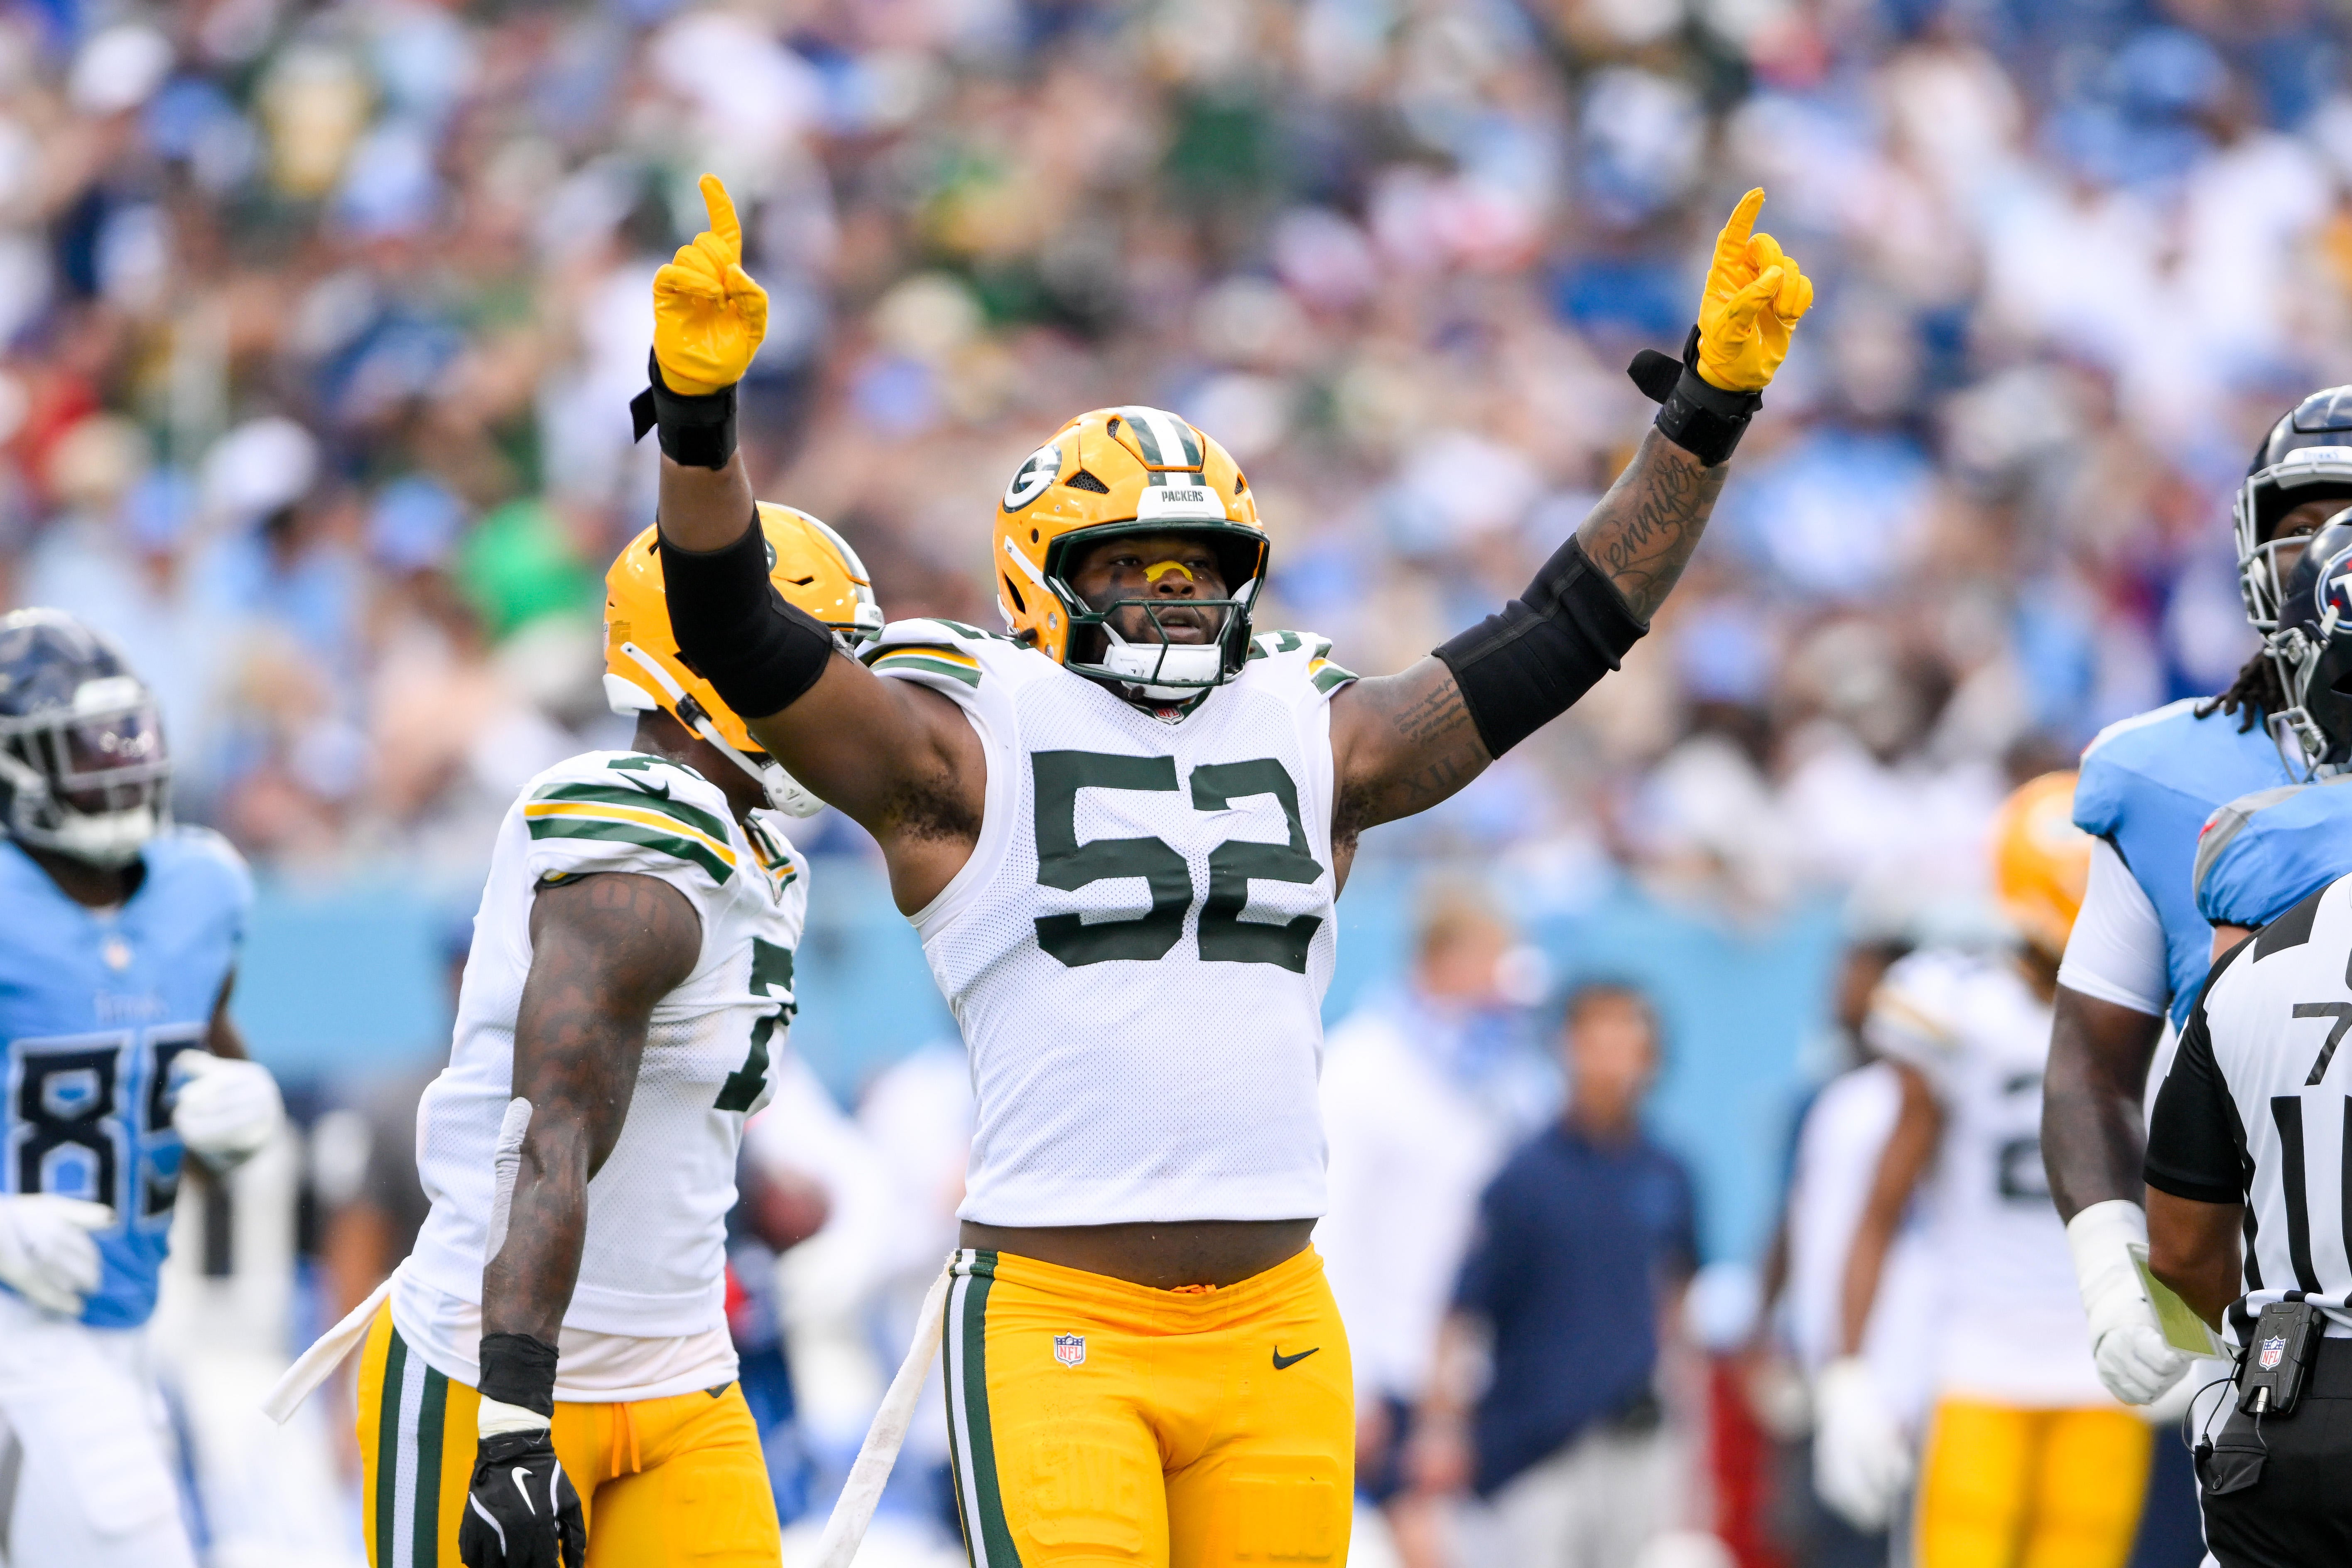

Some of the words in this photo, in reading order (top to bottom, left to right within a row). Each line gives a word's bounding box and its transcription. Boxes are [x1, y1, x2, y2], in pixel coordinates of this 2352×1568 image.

[1161, 490, 1204, 502] PACKERS
[1155, 708, 1179, 718] NFL
[1030, 749, 1324, 974] 52
[1059, 1345, 1081, 1360] NFL
[2262, 1350, 2278, 1365] NFL
